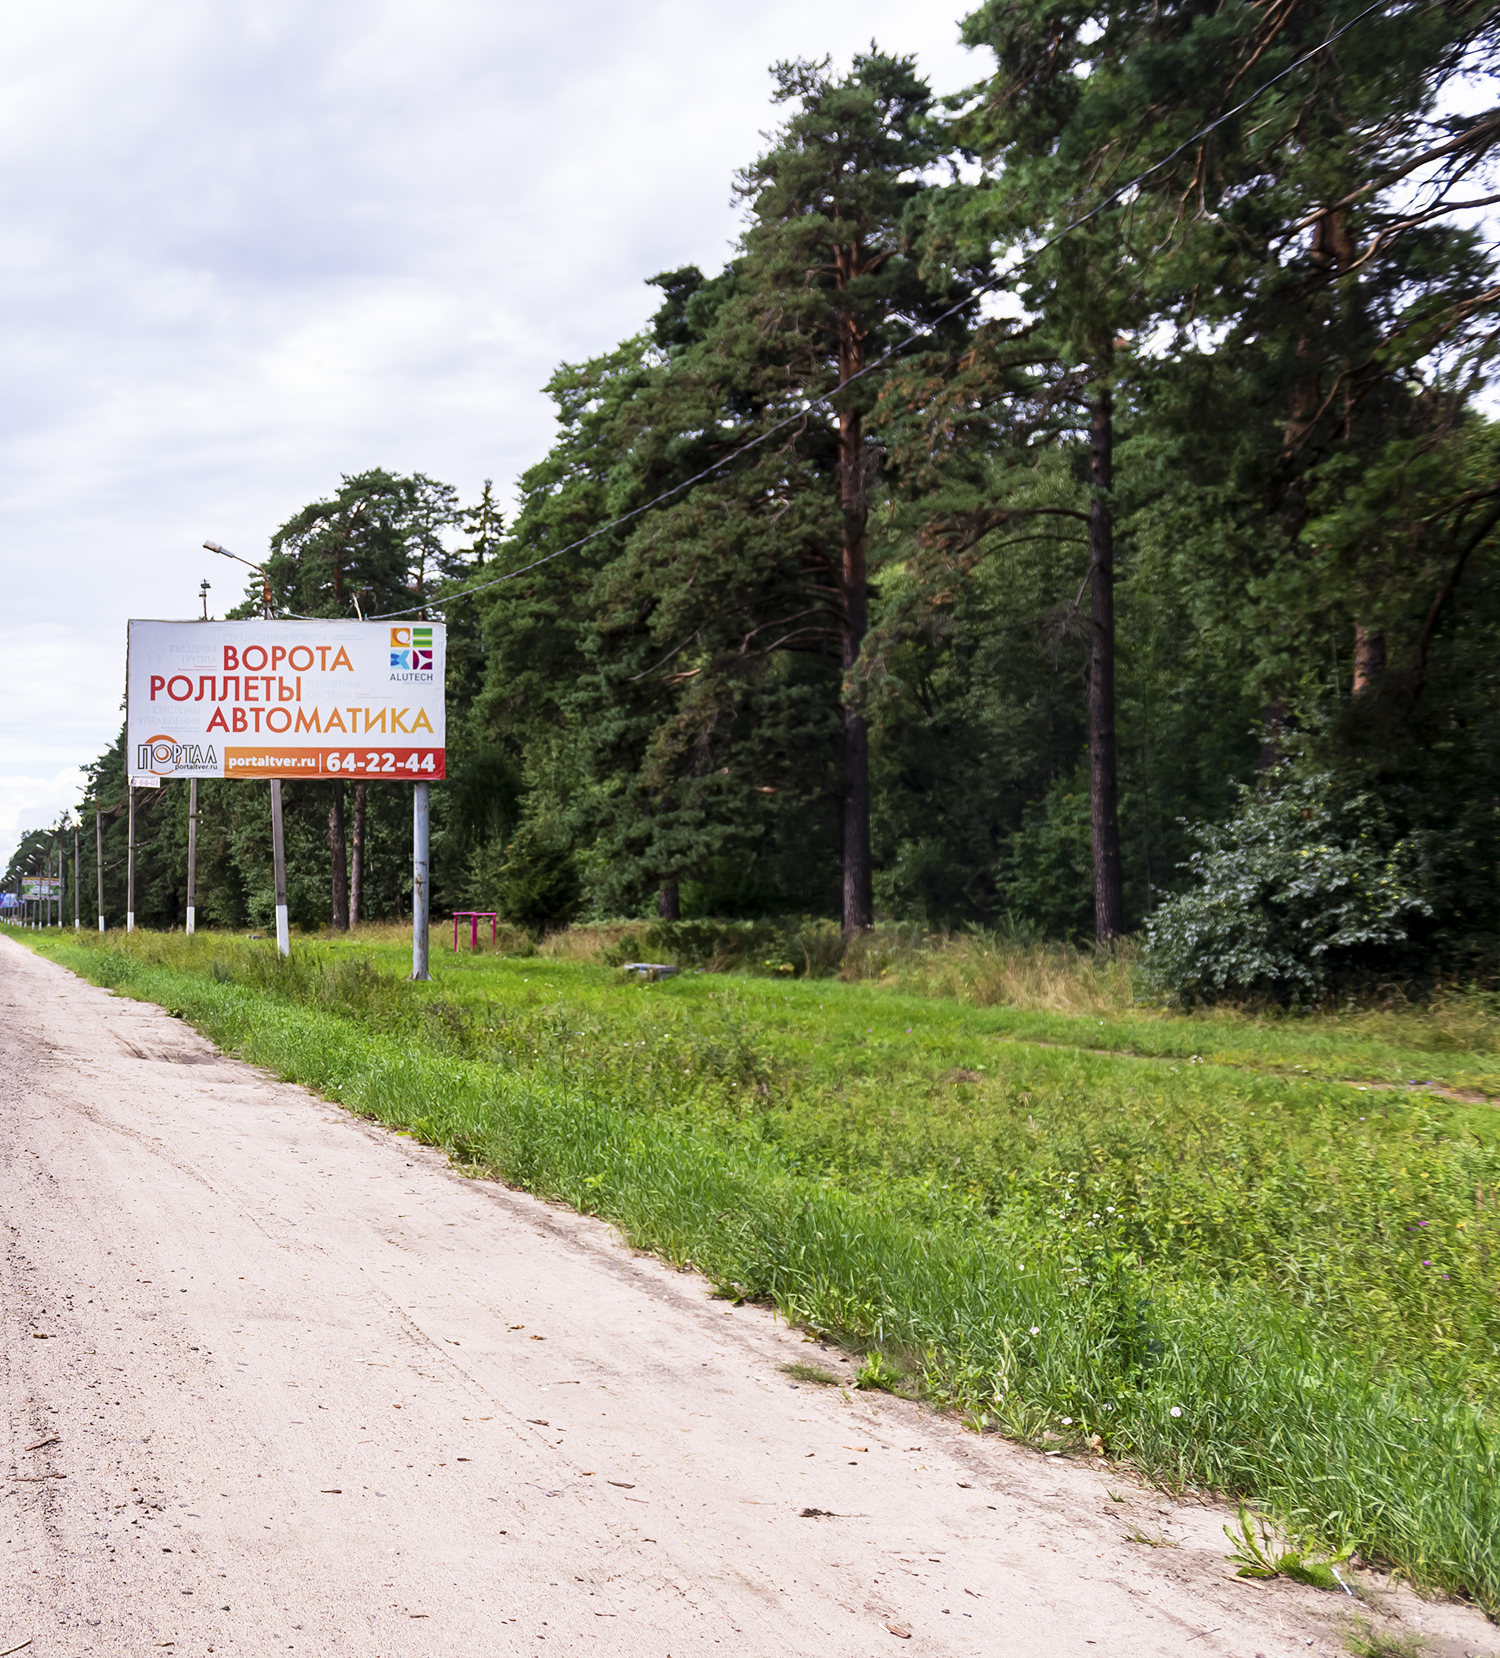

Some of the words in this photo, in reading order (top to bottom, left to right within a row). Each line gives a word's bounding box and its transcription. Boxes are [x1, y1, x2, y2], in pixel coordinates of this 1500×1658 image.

[223, 645, 354, 671] ВОРОТА
[150, 675, 300, 701] РОЛЛЕТЫ
[390, 673, 433, 681] ALUTECH
[206, 706, 434, 733] АВТОМАТИКА
[138, 744, 217, 769] ПОРТАЛ
[228, 755, 316, 769] portaltver.ru
[326, 752, 436, 773] 64-22-44
